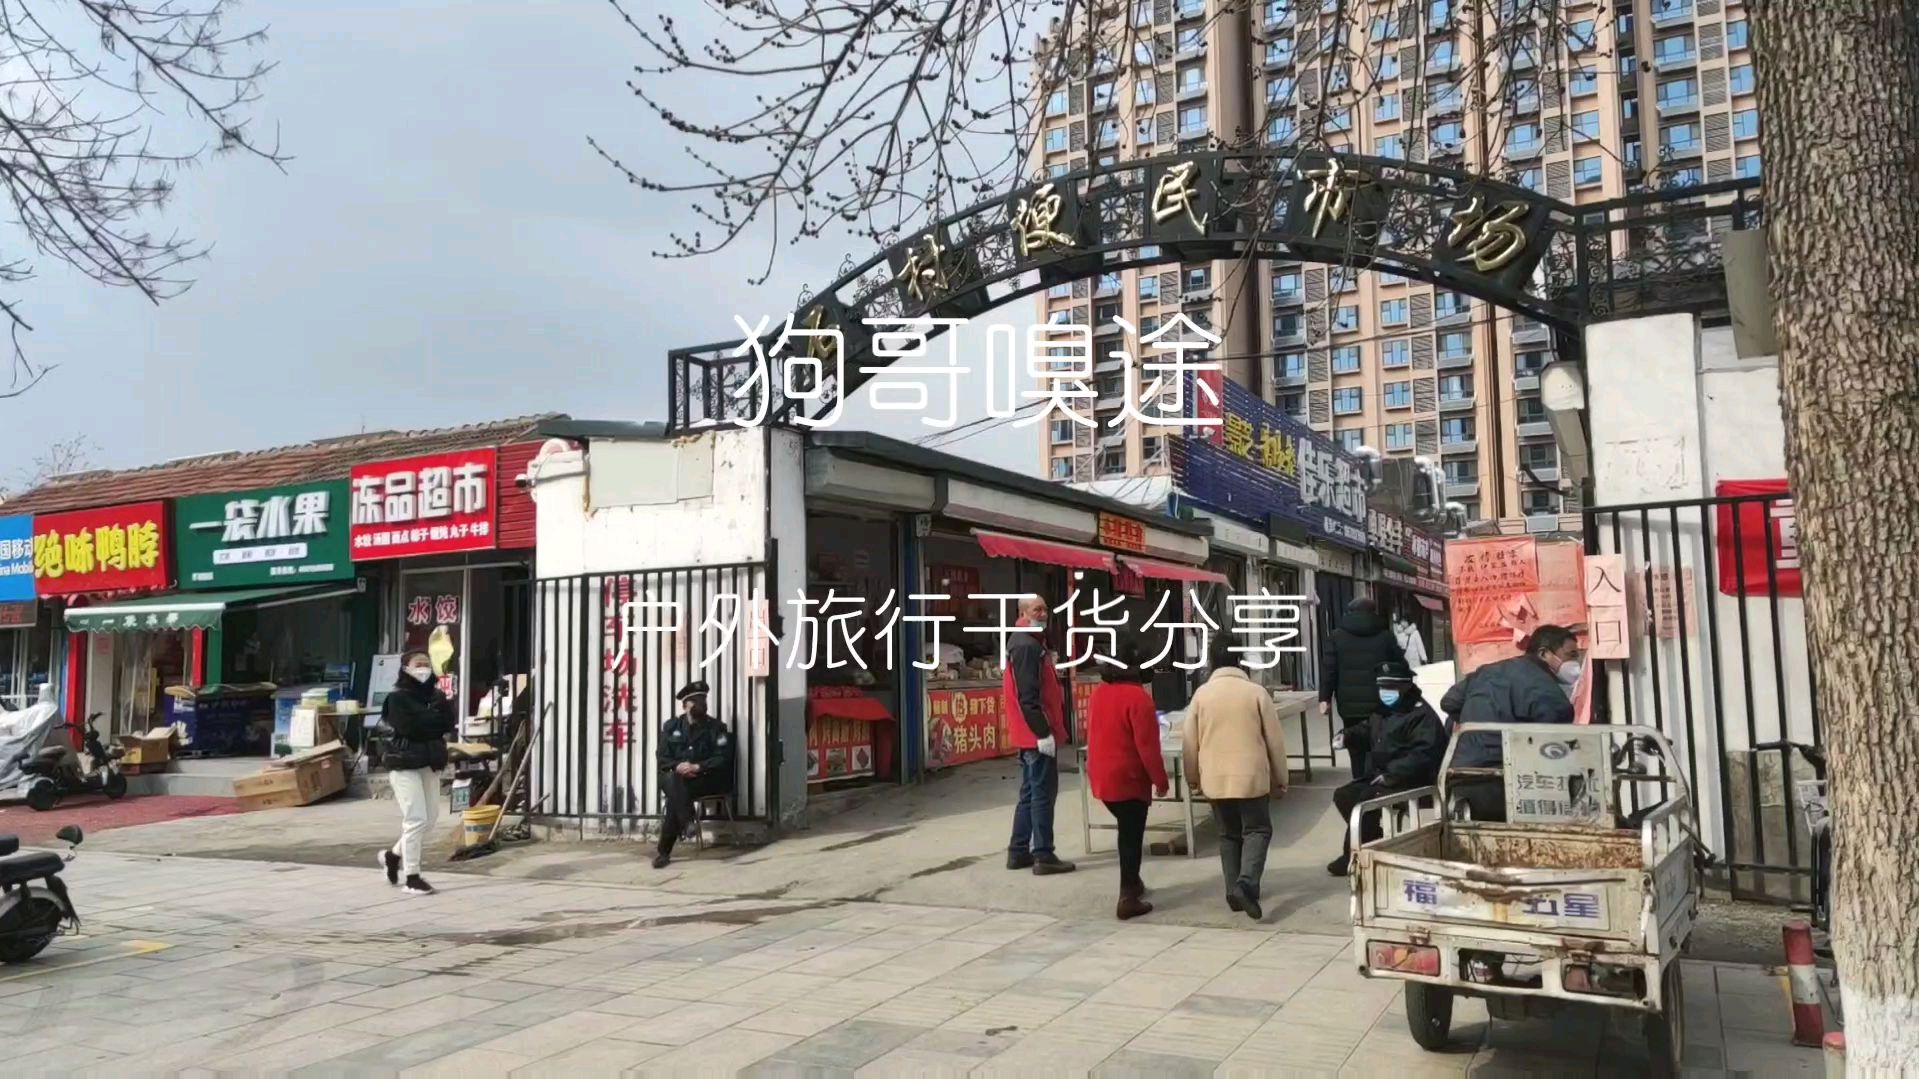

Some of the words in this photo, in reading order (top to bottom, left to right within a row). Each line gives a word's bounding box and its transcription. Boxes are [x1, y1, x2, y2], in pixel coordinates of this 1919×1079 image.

[189, 491, 330, 542] 一袋水果
[352, 462, 488, 525] 冻品超市
[34, 519, 160, 578] 绝味鸭脖
[408, 595, 457, 624] 水饺
[1590, 566, 1622, 645] 入口
[953, 724, 996, 753] 猪头肉
